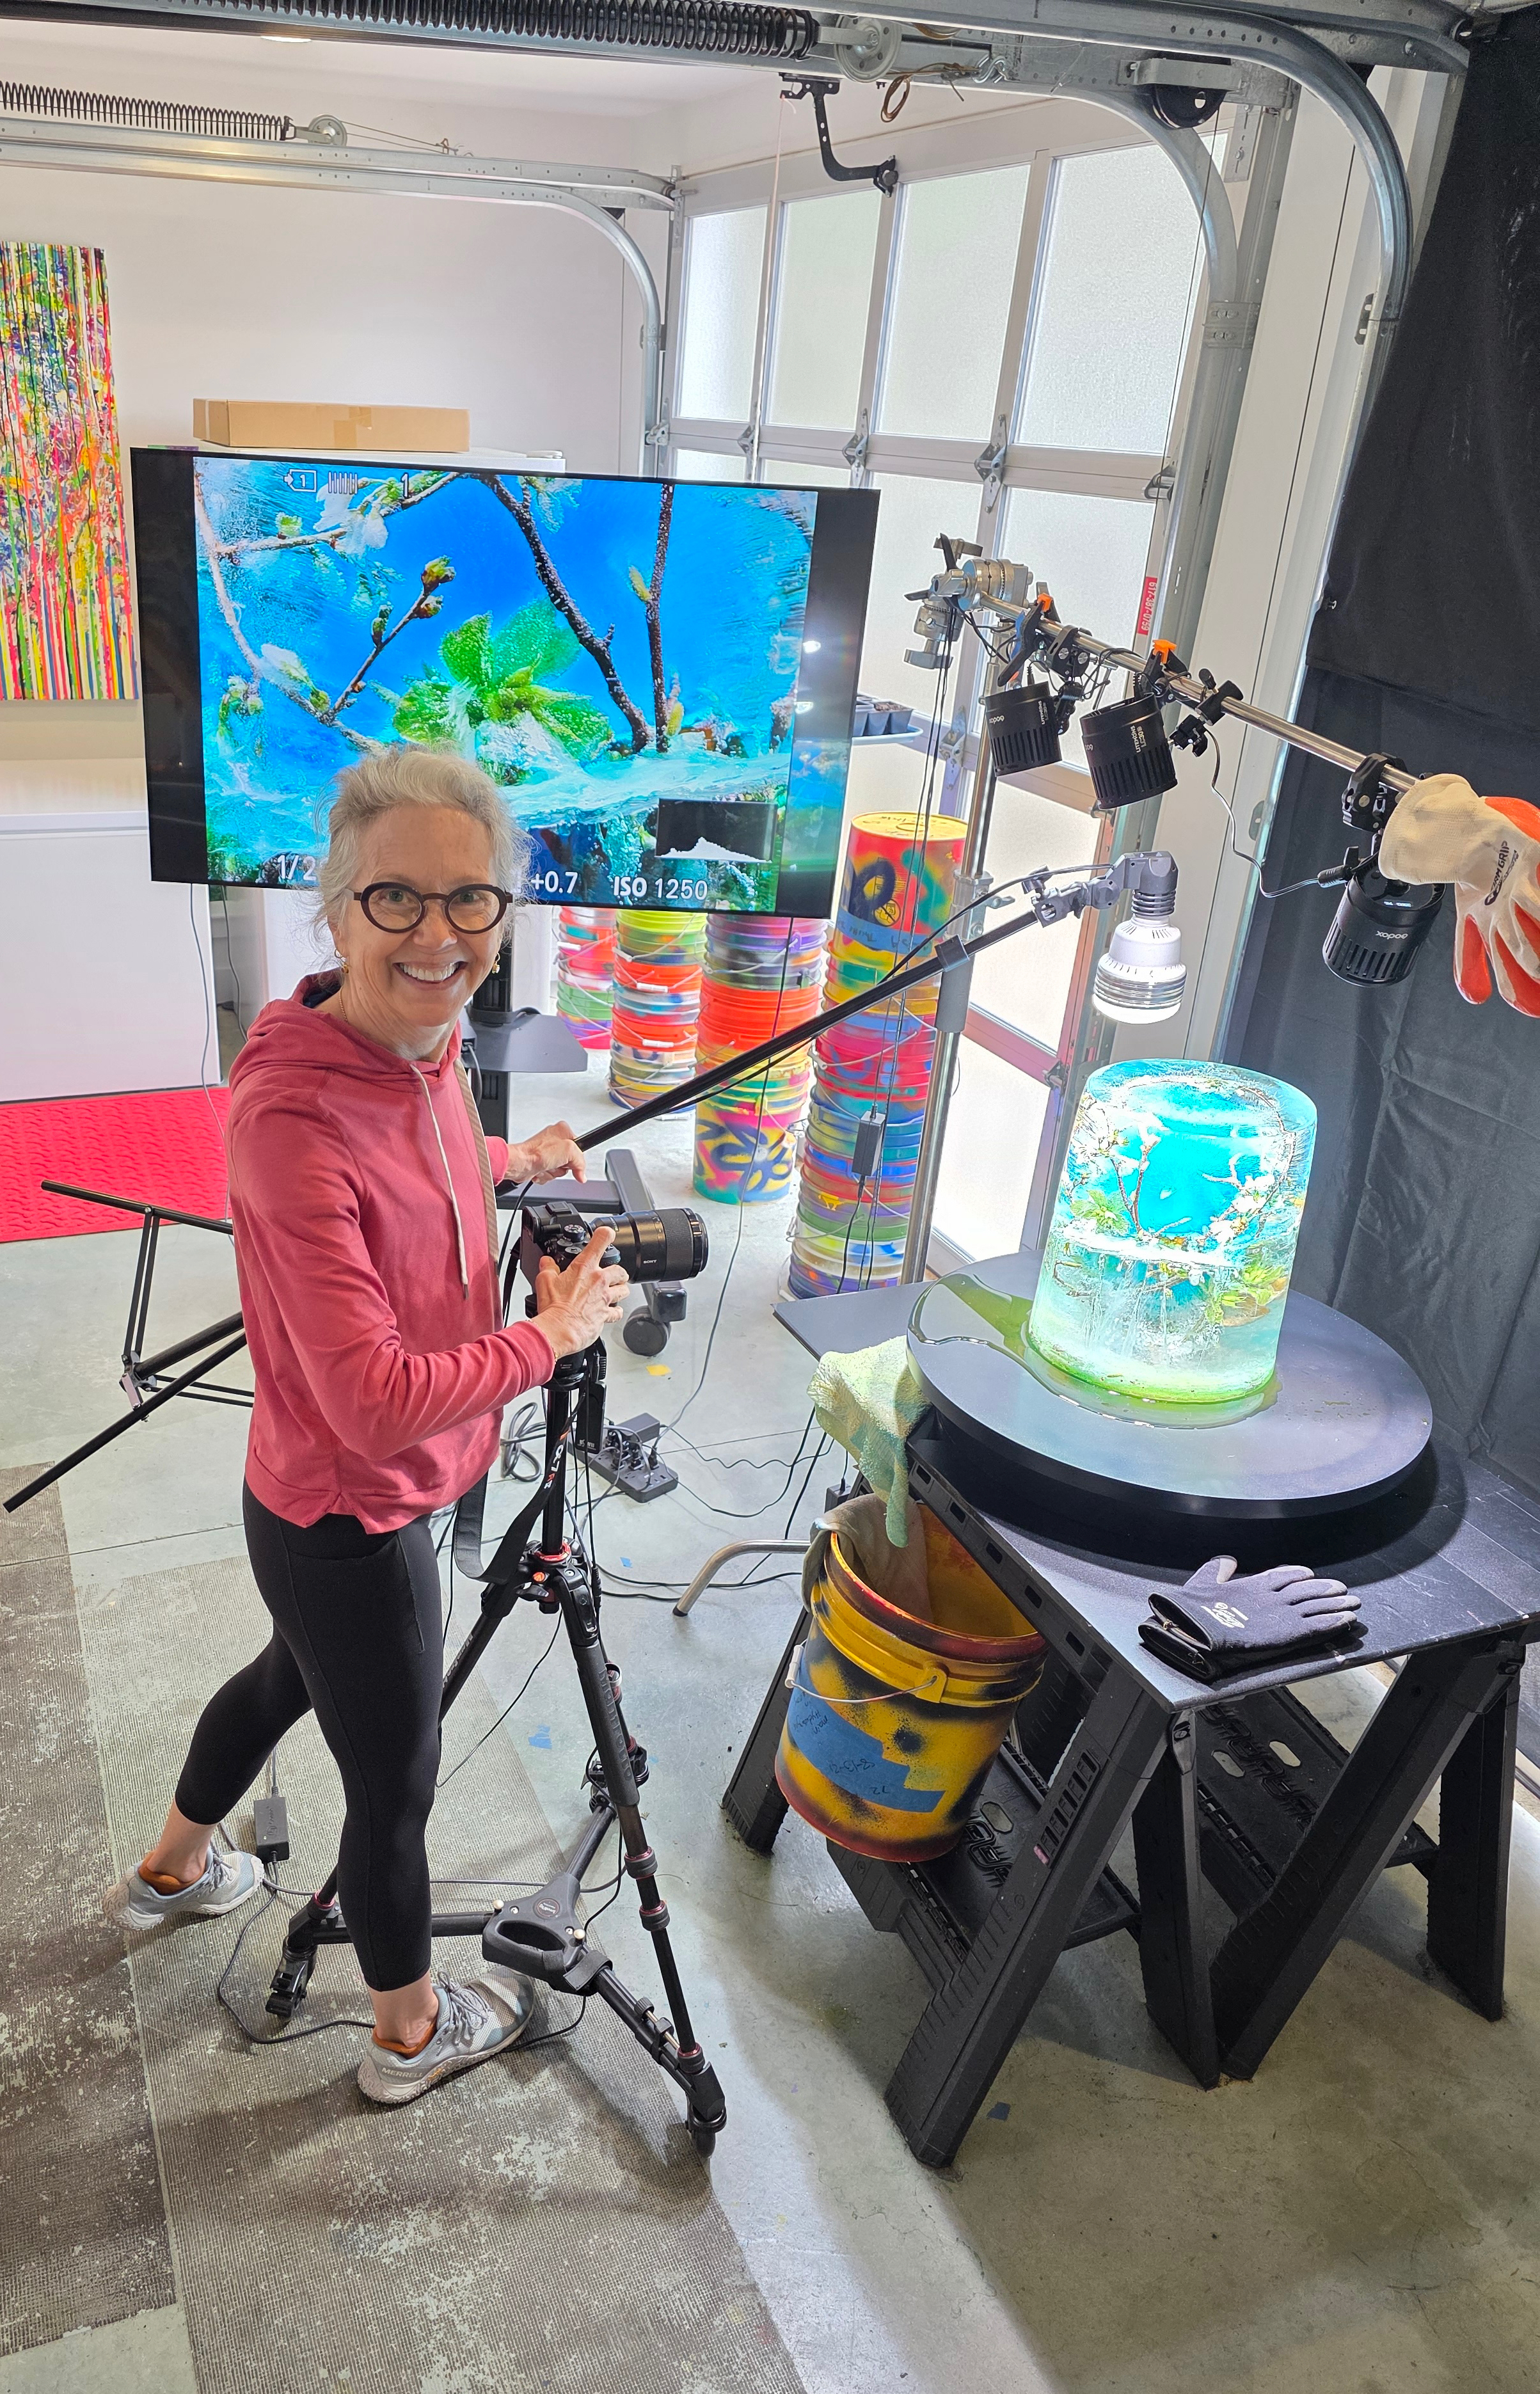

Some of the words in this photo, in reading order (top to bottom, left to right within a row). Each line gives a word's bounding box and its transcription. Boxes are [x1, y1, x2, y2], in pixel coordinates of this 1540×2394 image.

[1498, 840, 1510, 869] GRIP
[277, 854, 328, 881] 1/2
[530, 870, 579, 894] +0.7
[613, 876, 647, 896] ISO
[655, 878, 708, 900] 1250
[1376, 930, 1408, 940] Godox
[381, 2067, 423, 2078] MERRELL
